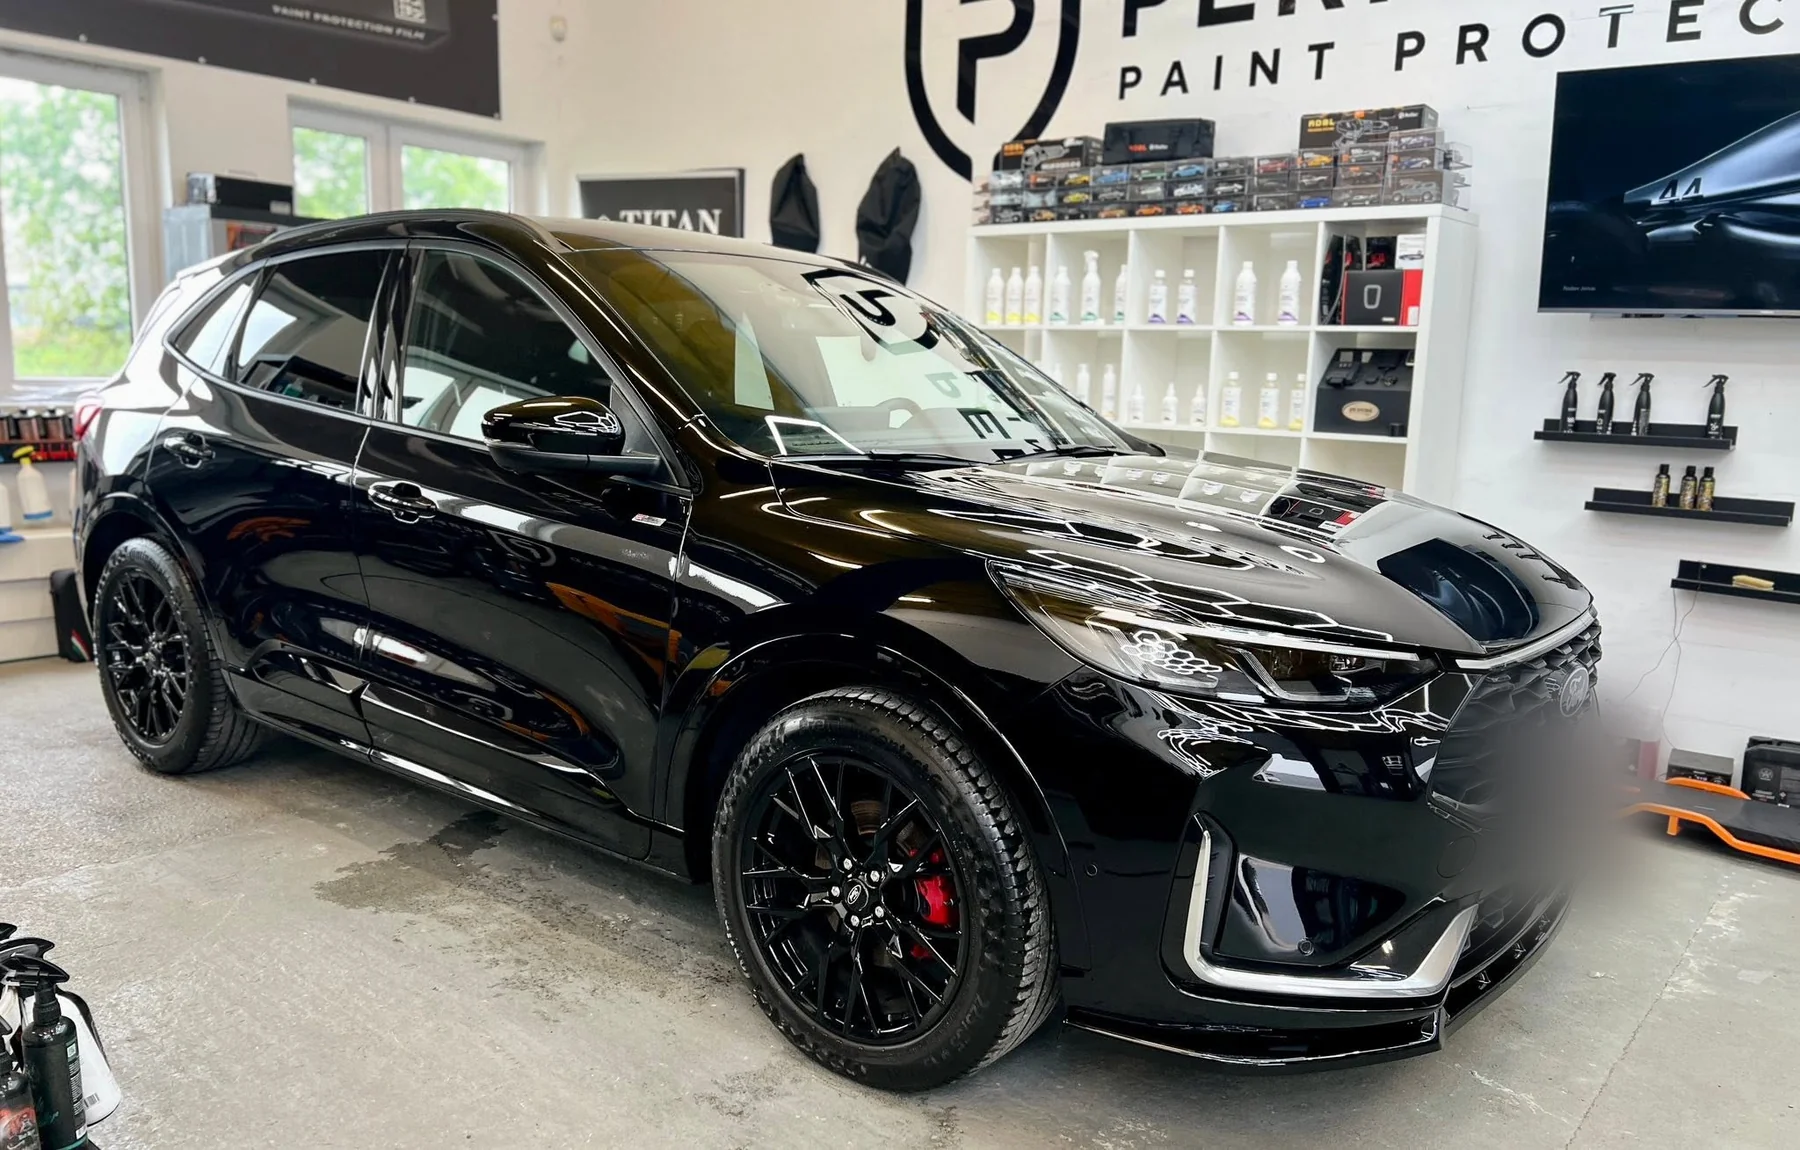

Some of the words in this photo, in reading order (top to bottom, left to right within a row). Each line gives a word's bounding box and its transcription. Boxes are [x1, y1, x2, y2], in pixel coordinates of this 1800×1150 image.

[272, 4, 311, 20] PAINT
[313, 12, 394, 35] PROTECTION
[395, 28, 426, 40] FILM
[1118, 41, 1335, 100] PAINT
[1394, 0, 1784, 72] PROTEC
[619, 208, 723, 236] TITAN
